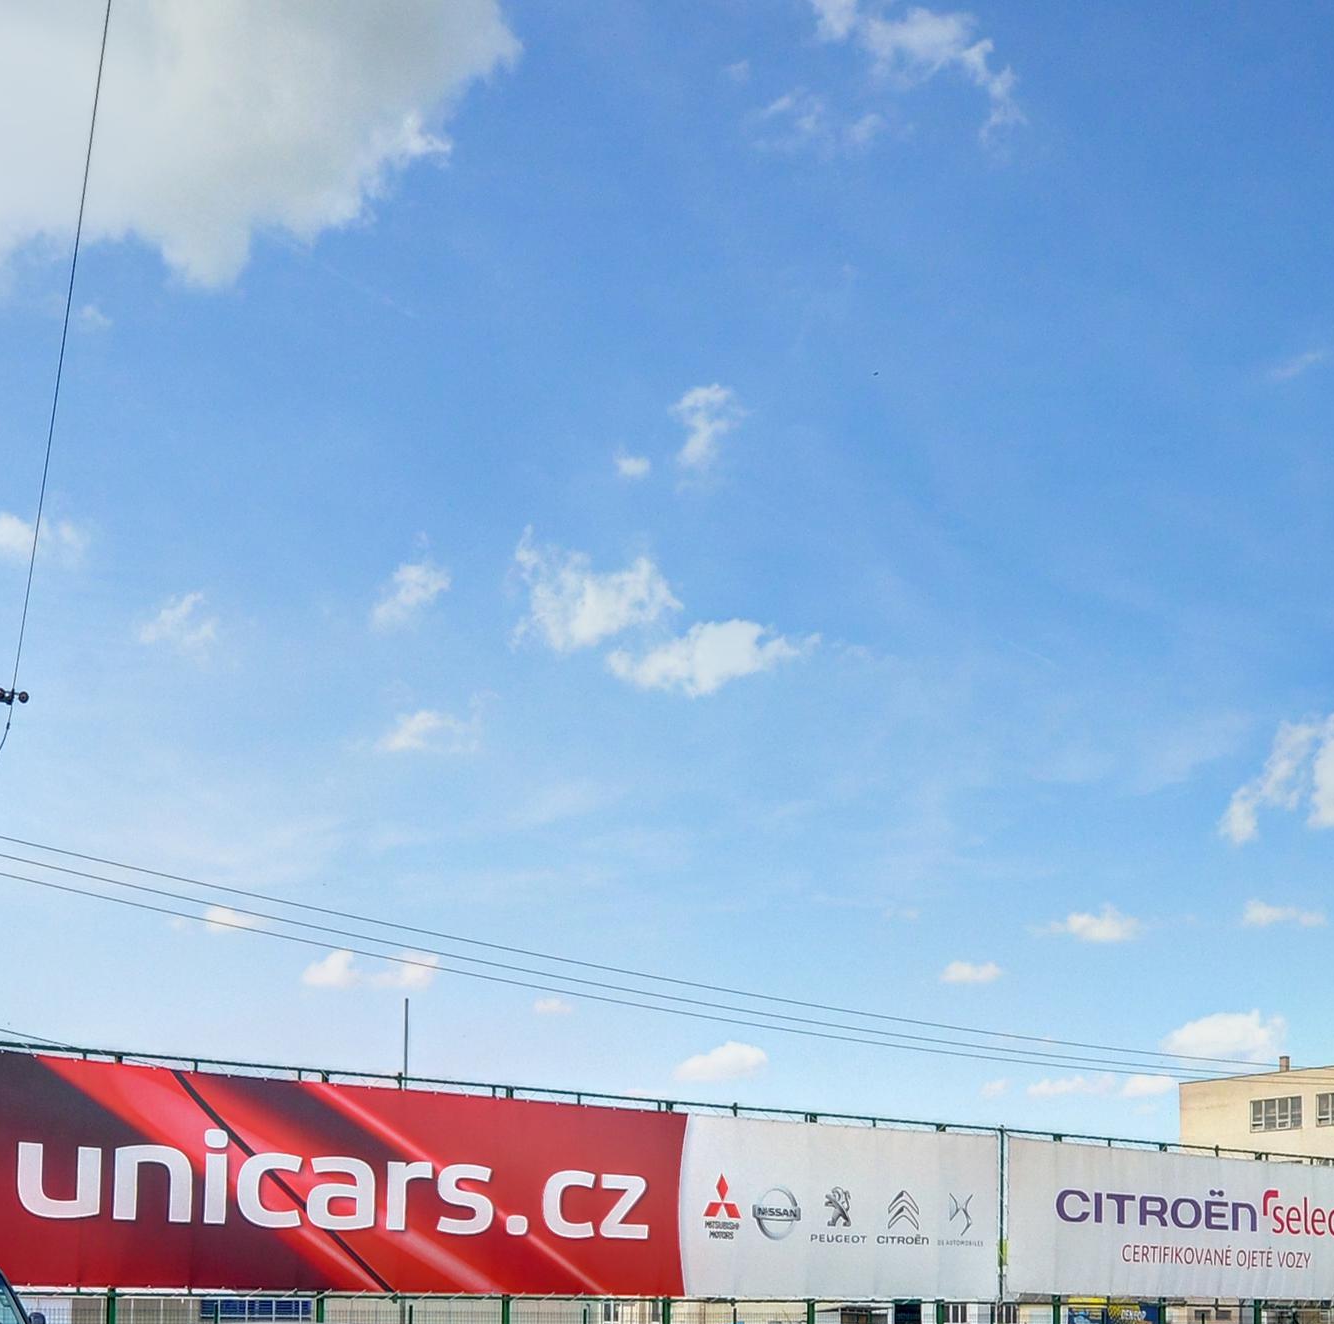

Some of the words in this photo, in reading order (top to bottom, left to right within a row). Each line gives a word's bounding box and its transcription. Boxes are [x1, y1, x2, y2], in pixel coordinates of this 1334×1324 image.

[17, 1129, 649, 1240] unicars.cz
[757, 1207, 797, 1218] NISSAN
[1055, 1189, 1258, 1232] CITROËN
[709, 1231, 734, 1239] MOTORS
[810, 1234, 867, 1243] PEUGEOT
[876, 1234, 929, 1245] CITROËN
[1122, 1244, 1231, 1267] CERTIFIKOVANÉ
[1236, 1246, 1273, 1269] OJETÉ
[1277, 1251, 1312, 1269] VOZY
